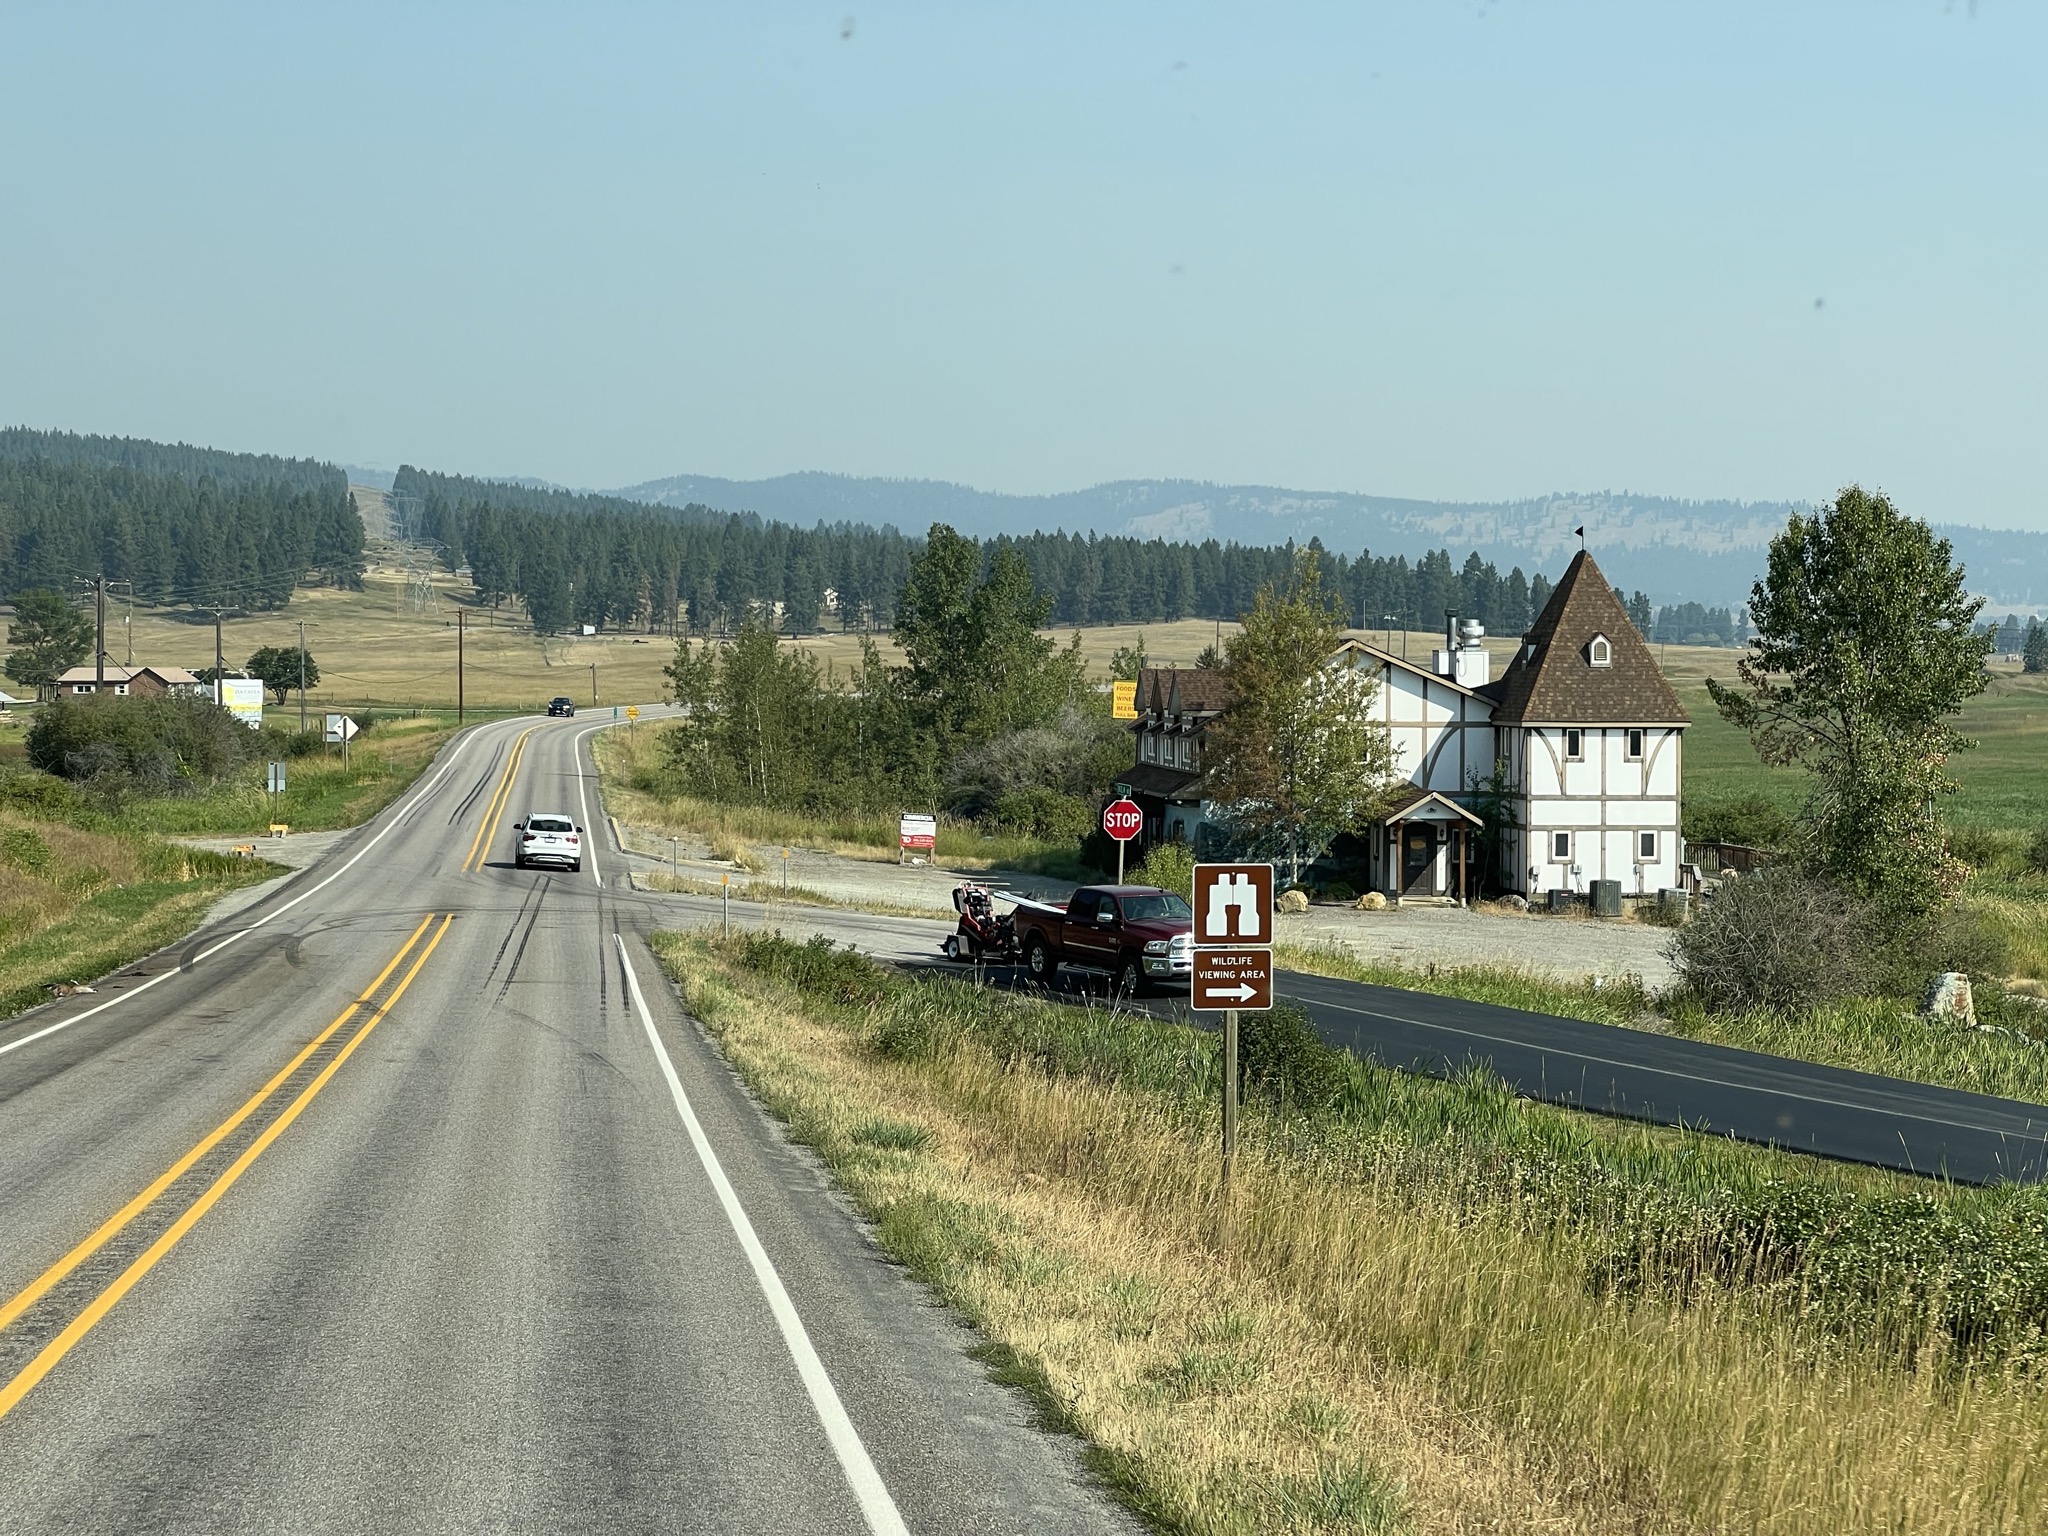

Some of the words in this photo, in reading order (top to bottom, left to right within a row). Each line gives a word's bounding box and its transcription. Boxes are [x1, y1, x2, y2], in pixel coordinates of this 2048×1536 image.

[1106, 812, 1140, 828] STOP
[1211, 956, 1253, 966] WILDLIFE
[1199, 970, 1236, 979] VIEWING
[1239, 970, 1266, 979] AREA
